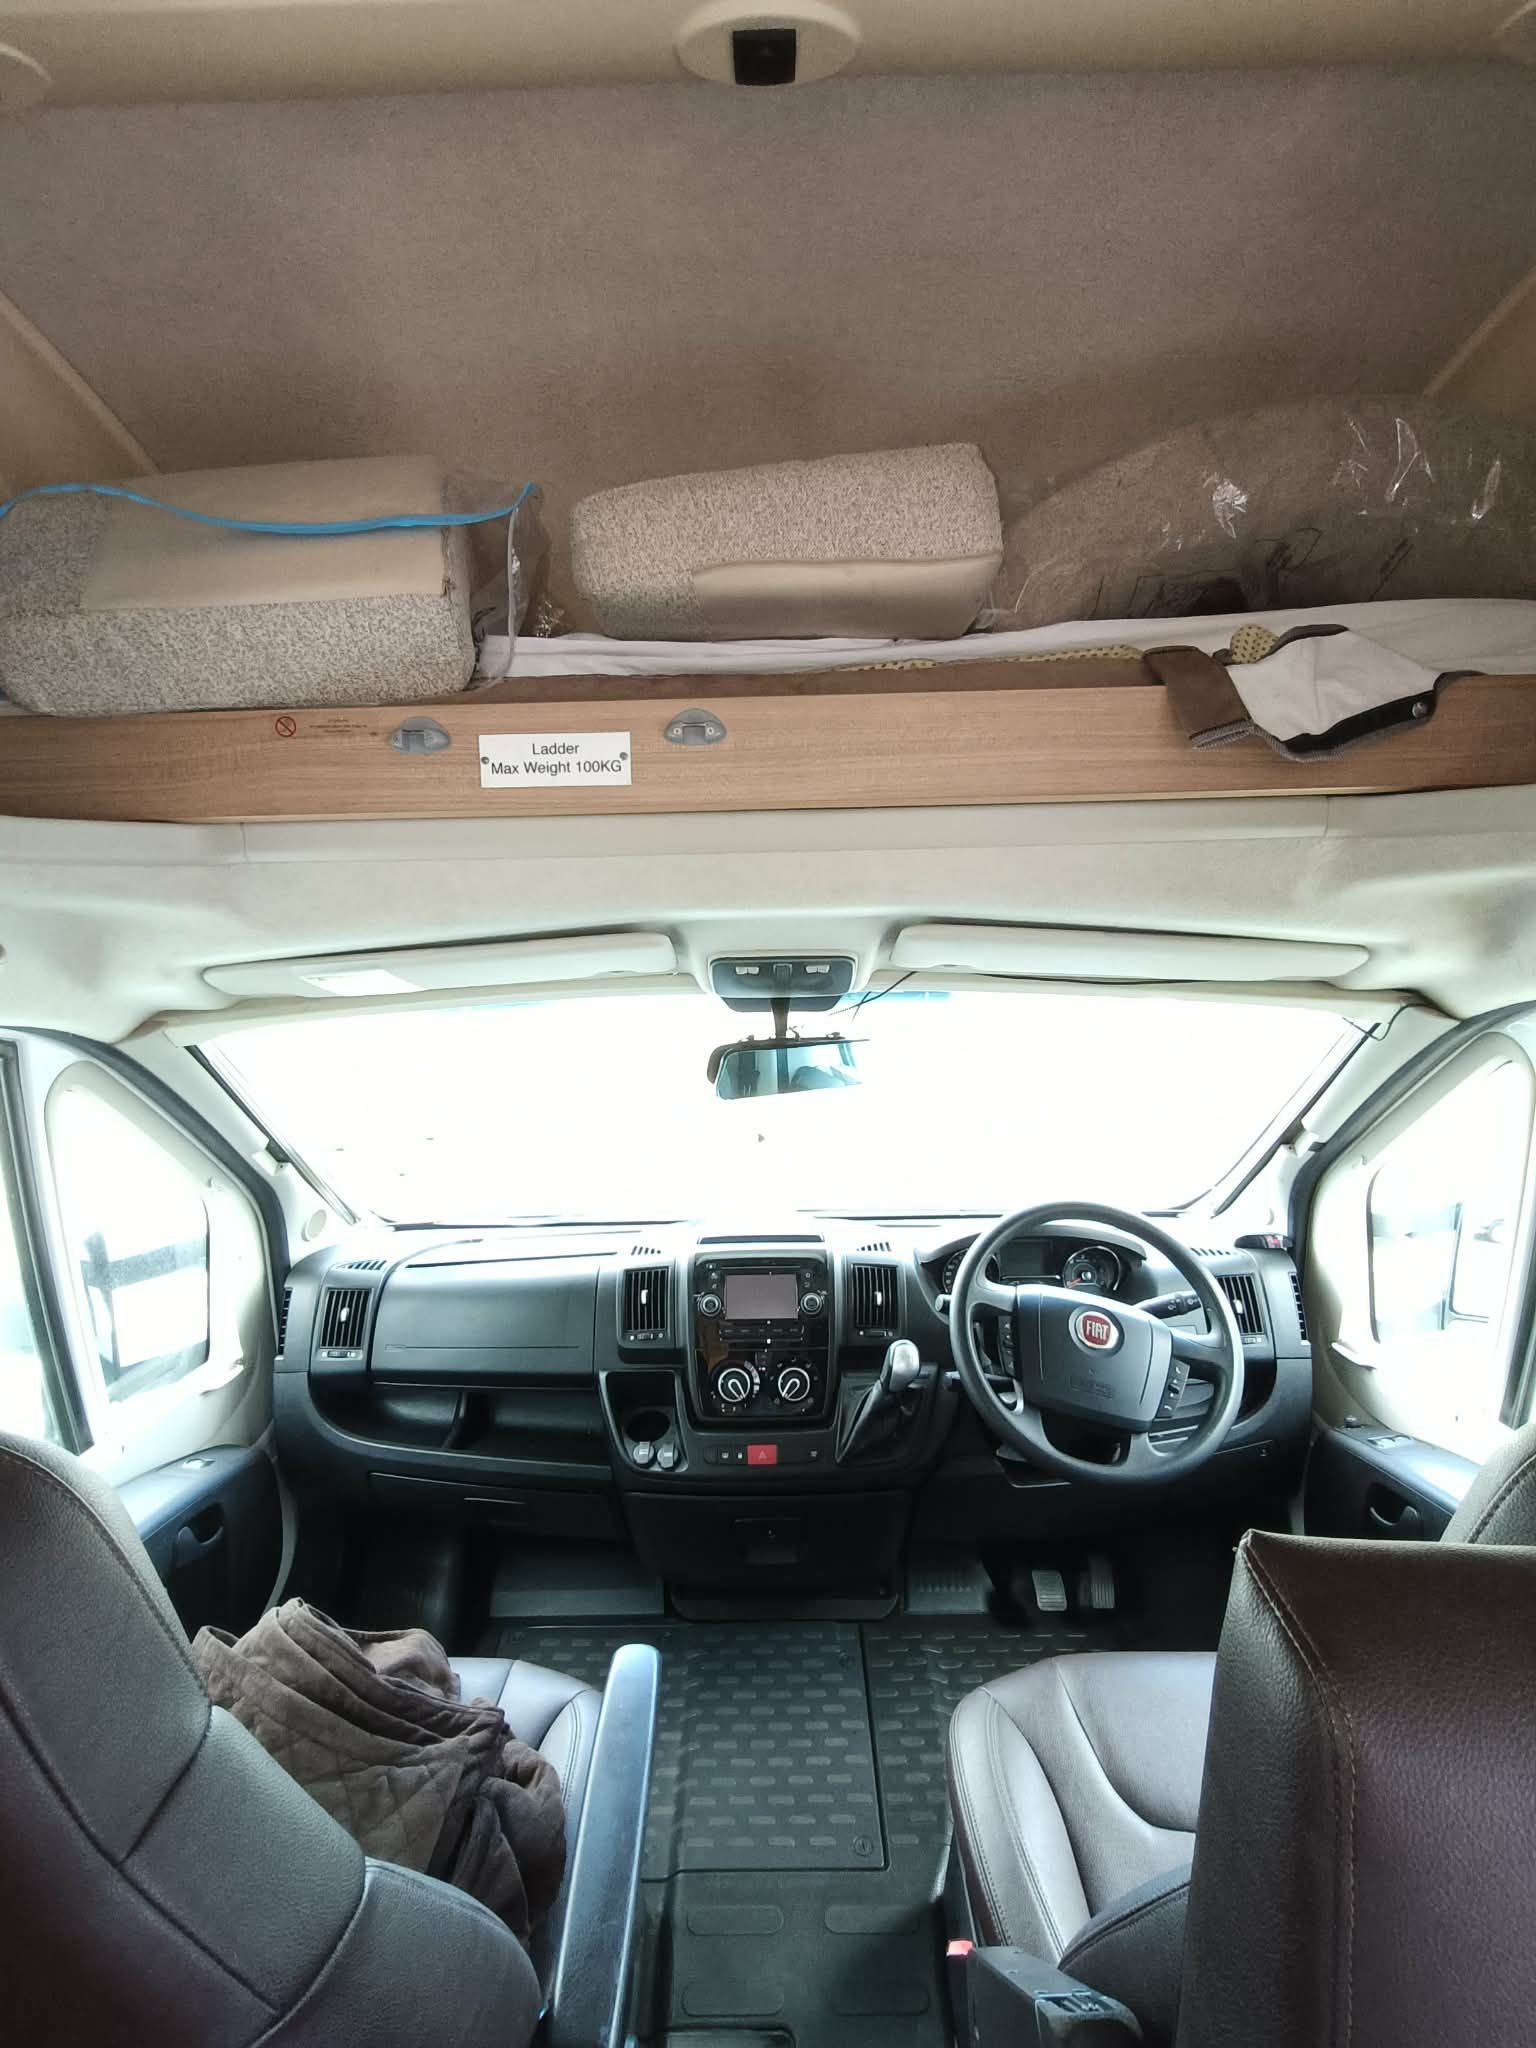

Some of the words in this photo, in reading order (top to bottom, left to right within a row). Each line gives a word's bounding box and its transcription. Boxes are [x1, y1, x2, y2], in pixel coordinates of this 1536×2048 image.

[532, 742, 580, 755] Ladder
[491, 762, 519, 775] Max
[523, 761, 571, 777] Weight
[576, 759, 622, 774] 100KG
[1086, 1319, 1109, 1341] FIAT
